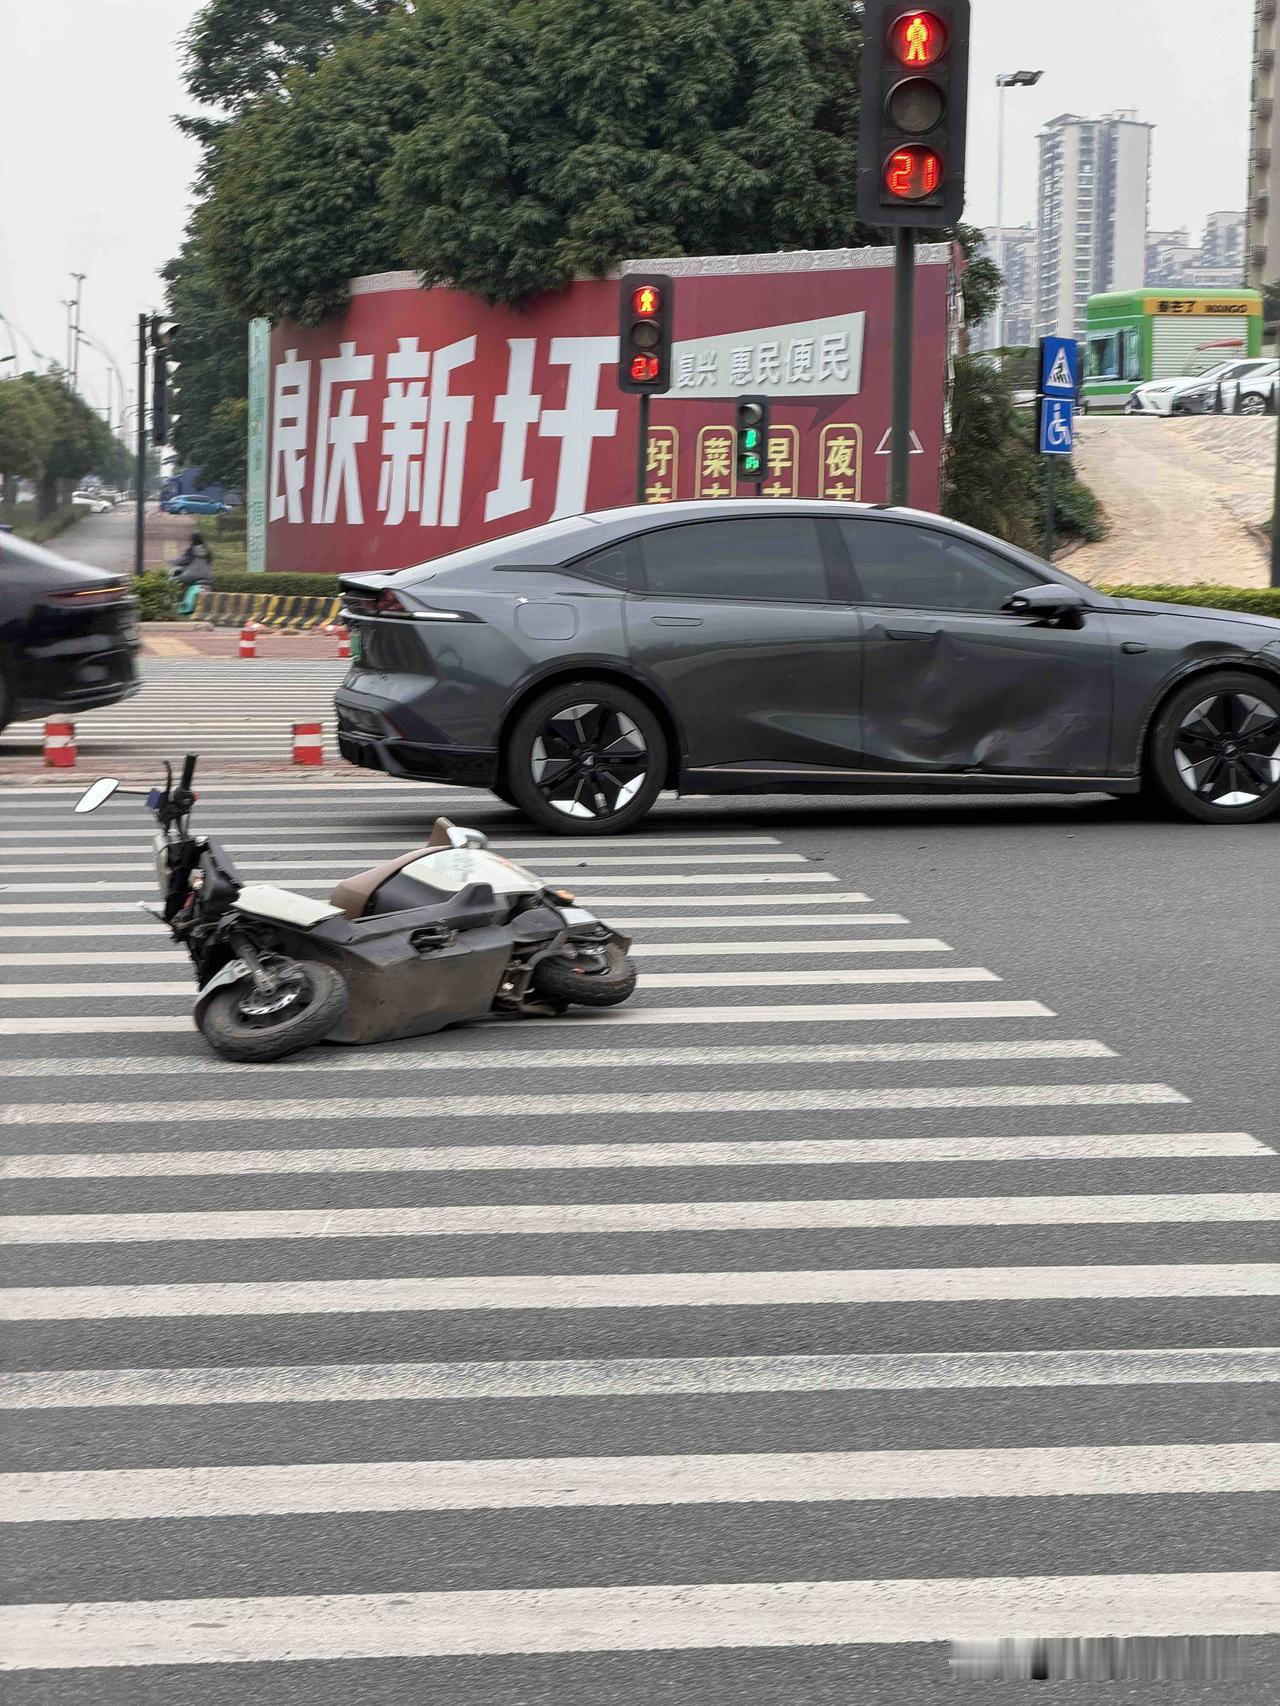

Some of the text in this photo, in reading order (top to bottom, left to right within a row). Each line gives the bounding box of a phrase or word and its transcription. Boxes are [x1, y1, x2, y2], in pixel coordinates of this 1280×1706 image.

[889, 155, 937, 191] 21
[632, 357, 659, 378] 21
[729, 331, 850, 386] 惠民便民
[270, 335, 620, 527] 良庆新圩
